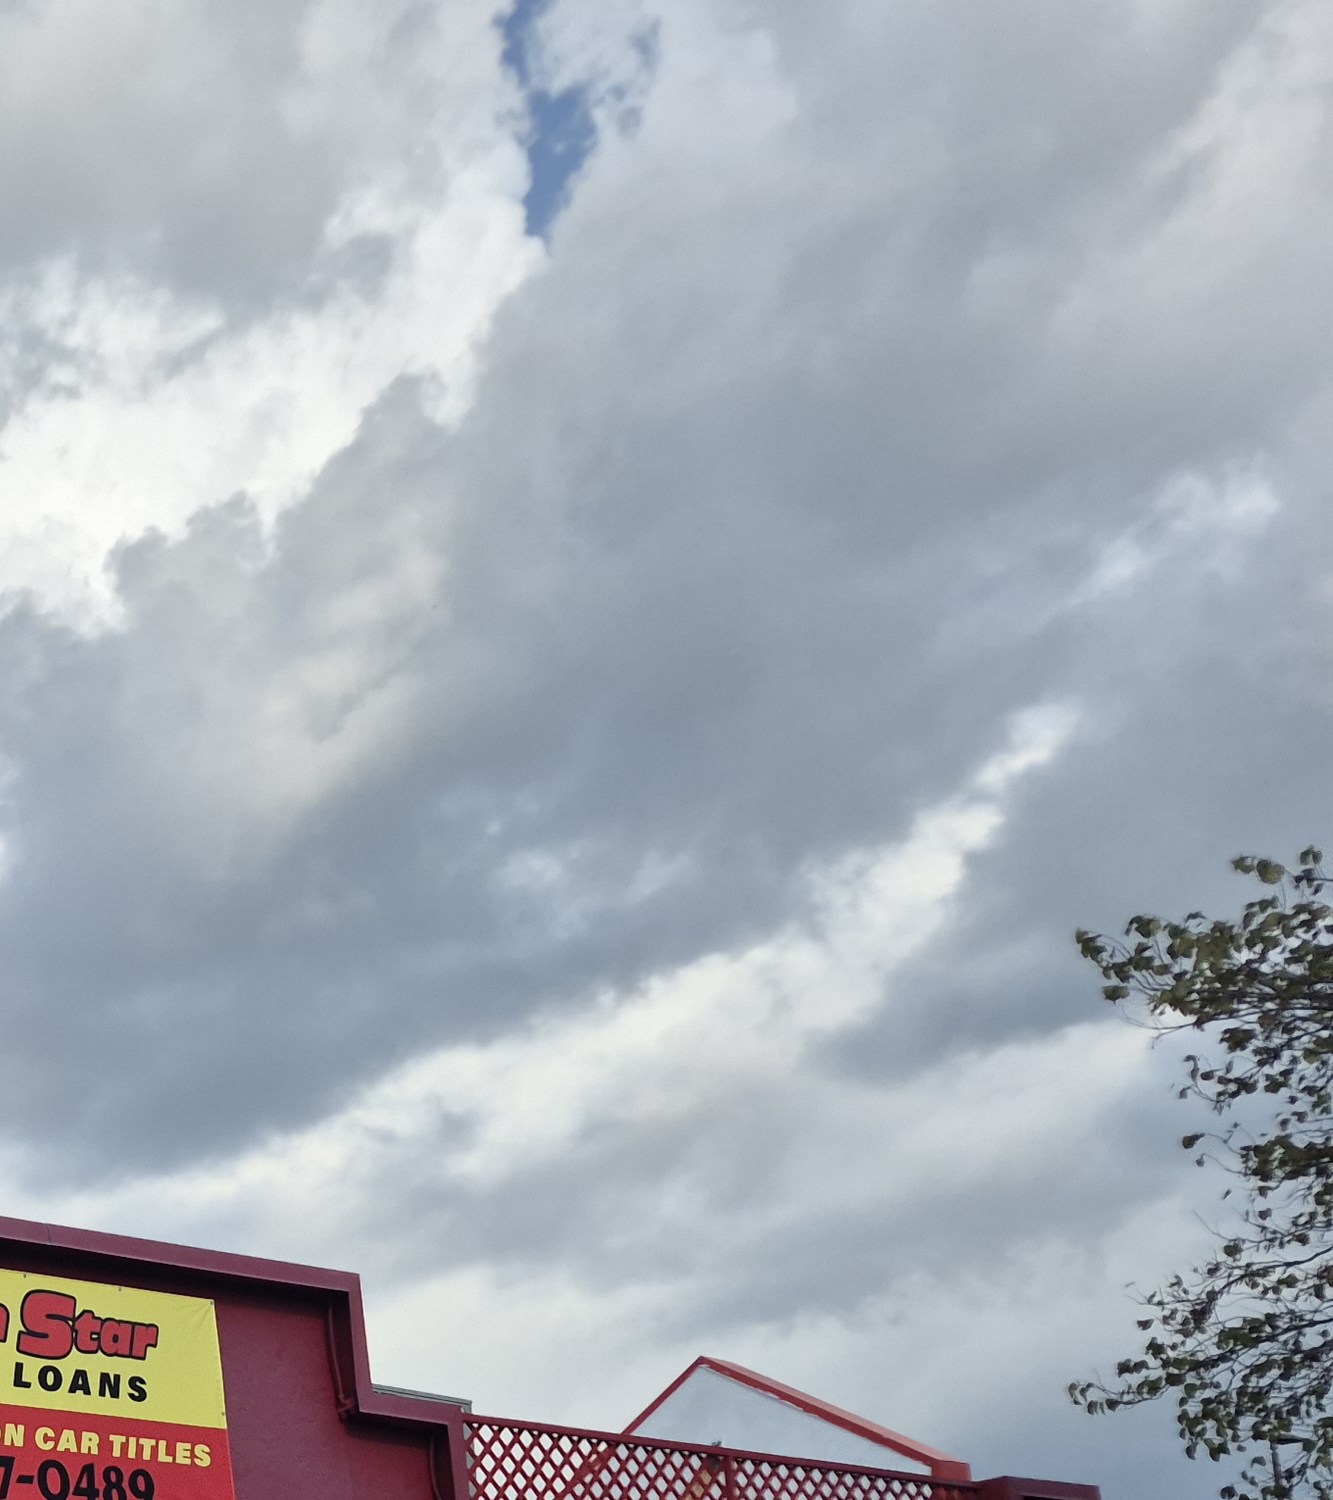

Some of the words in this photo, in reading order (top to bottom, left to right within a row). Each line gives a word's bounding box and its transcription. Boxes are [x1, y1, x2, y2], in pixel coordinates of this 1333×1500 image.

[16, 1289, 159, 1361] Star
[13, 1362, 148, 1403] LOANS
[35, 1427, 100, 1455] CAR
[109, 1434, 212, 1467] TITLES
